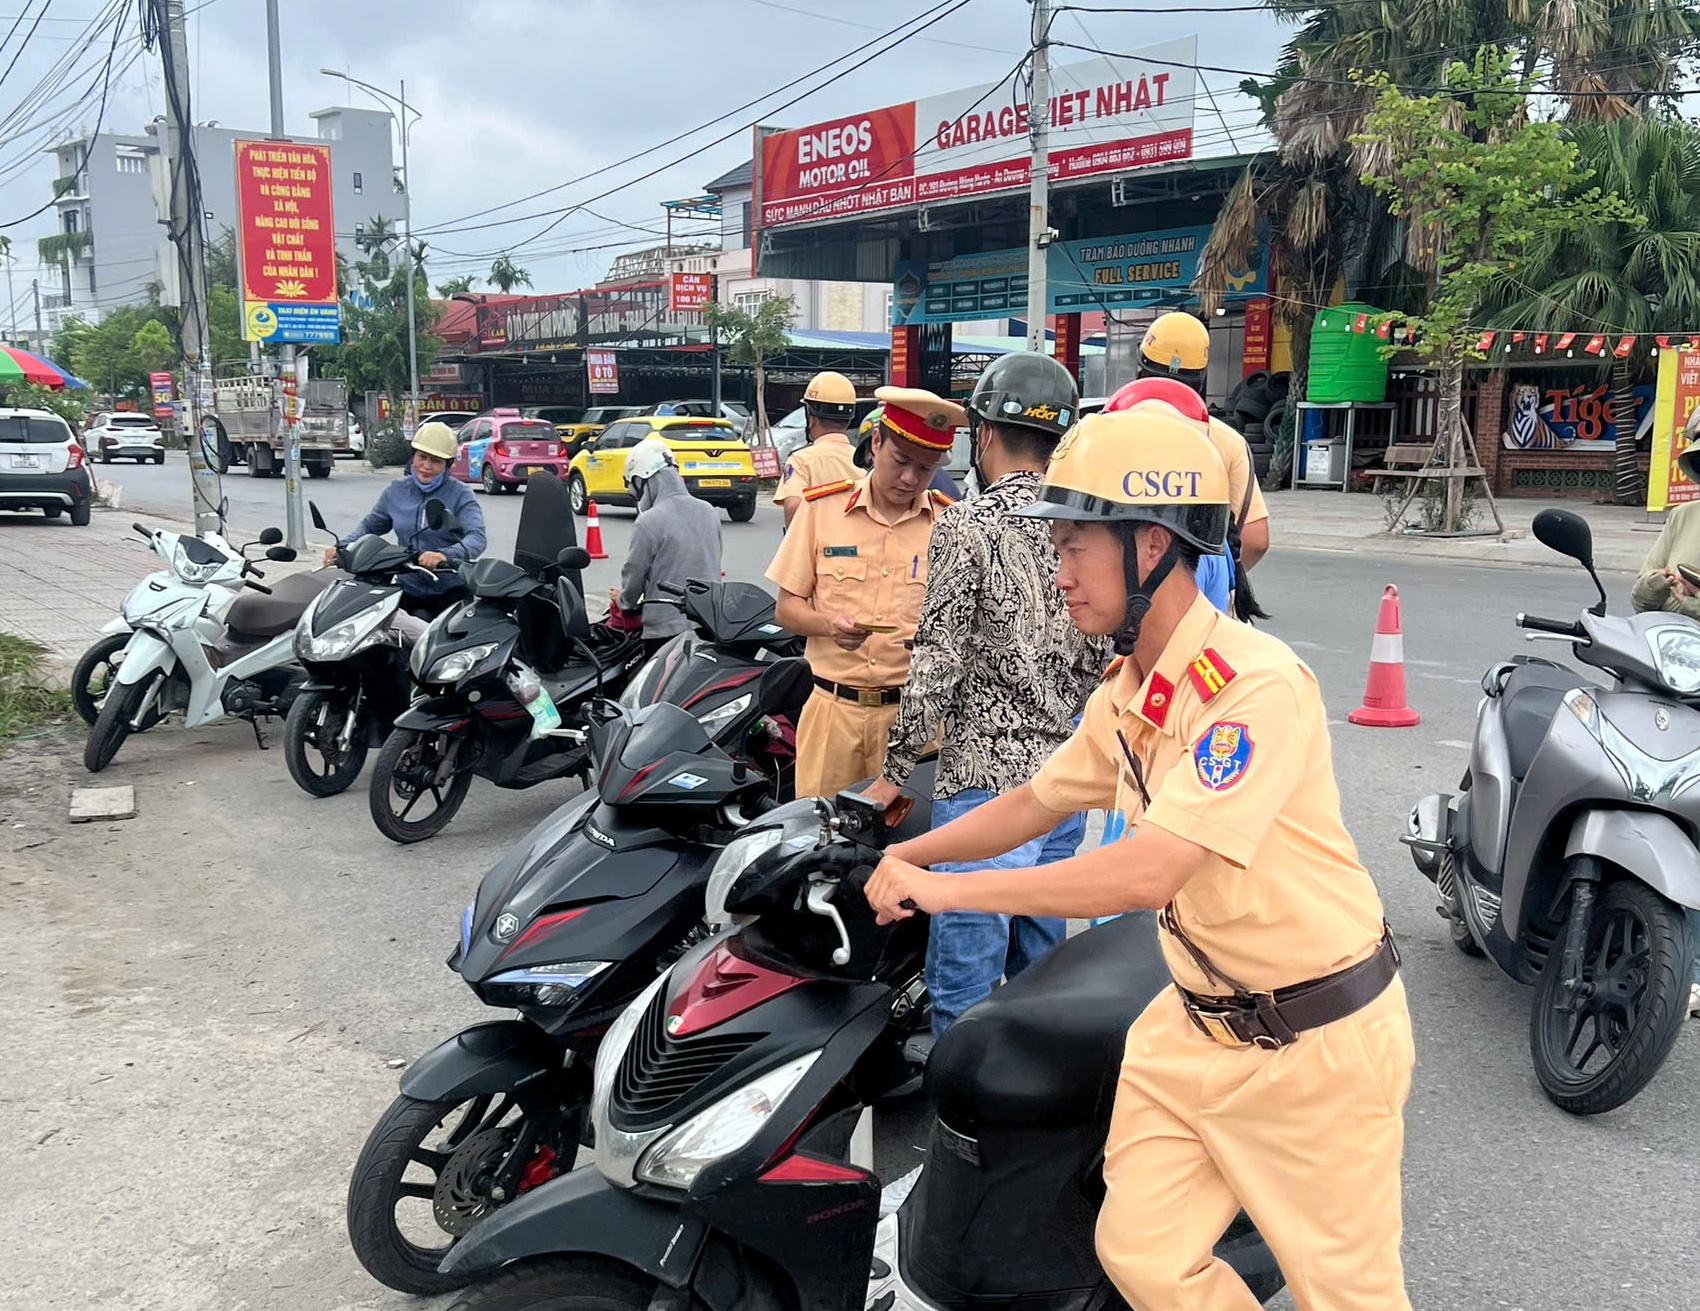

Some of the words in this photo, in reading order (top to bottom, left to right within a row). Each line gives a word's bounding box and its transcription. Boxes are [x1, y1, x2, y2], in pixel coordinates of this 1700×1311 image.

[936, 103, 1029, 150] GARAGE
[1095, 72, 1170, 118] NHẬT
[798, 120, 872, 165] ENEOS
[799, 163, 845, 189] MOTOR
[849, 158, 871, 181] OIL
[765, 205, 786, 224] SỨC
[861, 188, 888, 208] NHẬT
[274, 217, 288, 229] CAO
[1080, 246, 1105, 267] TRẠM
[1106, 240, 1125, 260] BẢO
[1161, 236, 1196, 254] NHANH
[1094, 267, 1124, 285] FULL
[1127, 260, 1181, 283] SERVICE
[675, 295, 690, 303] 100
[1122, 470, 1202, 498] CSGT
[806, 1199, 865, 1225] HONDA
